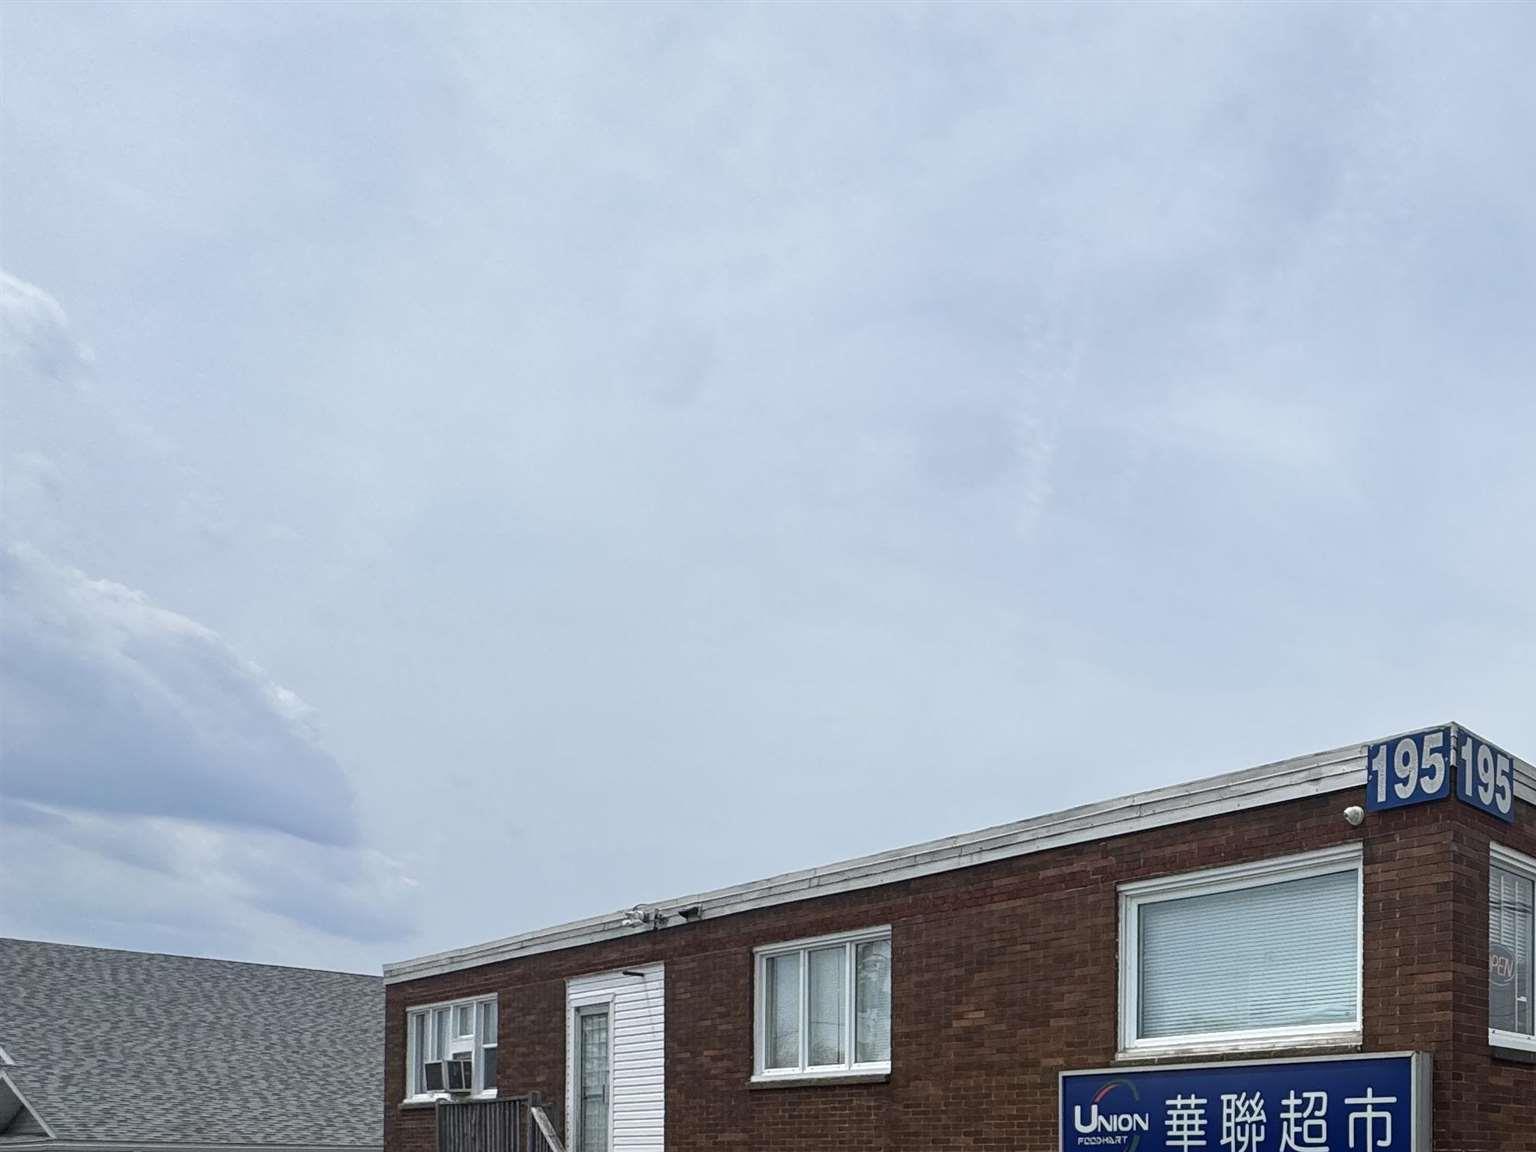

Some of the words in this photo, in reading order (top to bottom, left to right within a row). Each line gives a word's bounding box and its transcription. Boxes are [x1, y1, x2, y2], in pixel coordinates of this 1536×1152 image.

[1372, 732, 1445, 803] 195
[1462, 737, 1511, 814] 195
[1490, 954, 1513, 977] PEN
[1074, 1104, 1149, 1133] UNION
